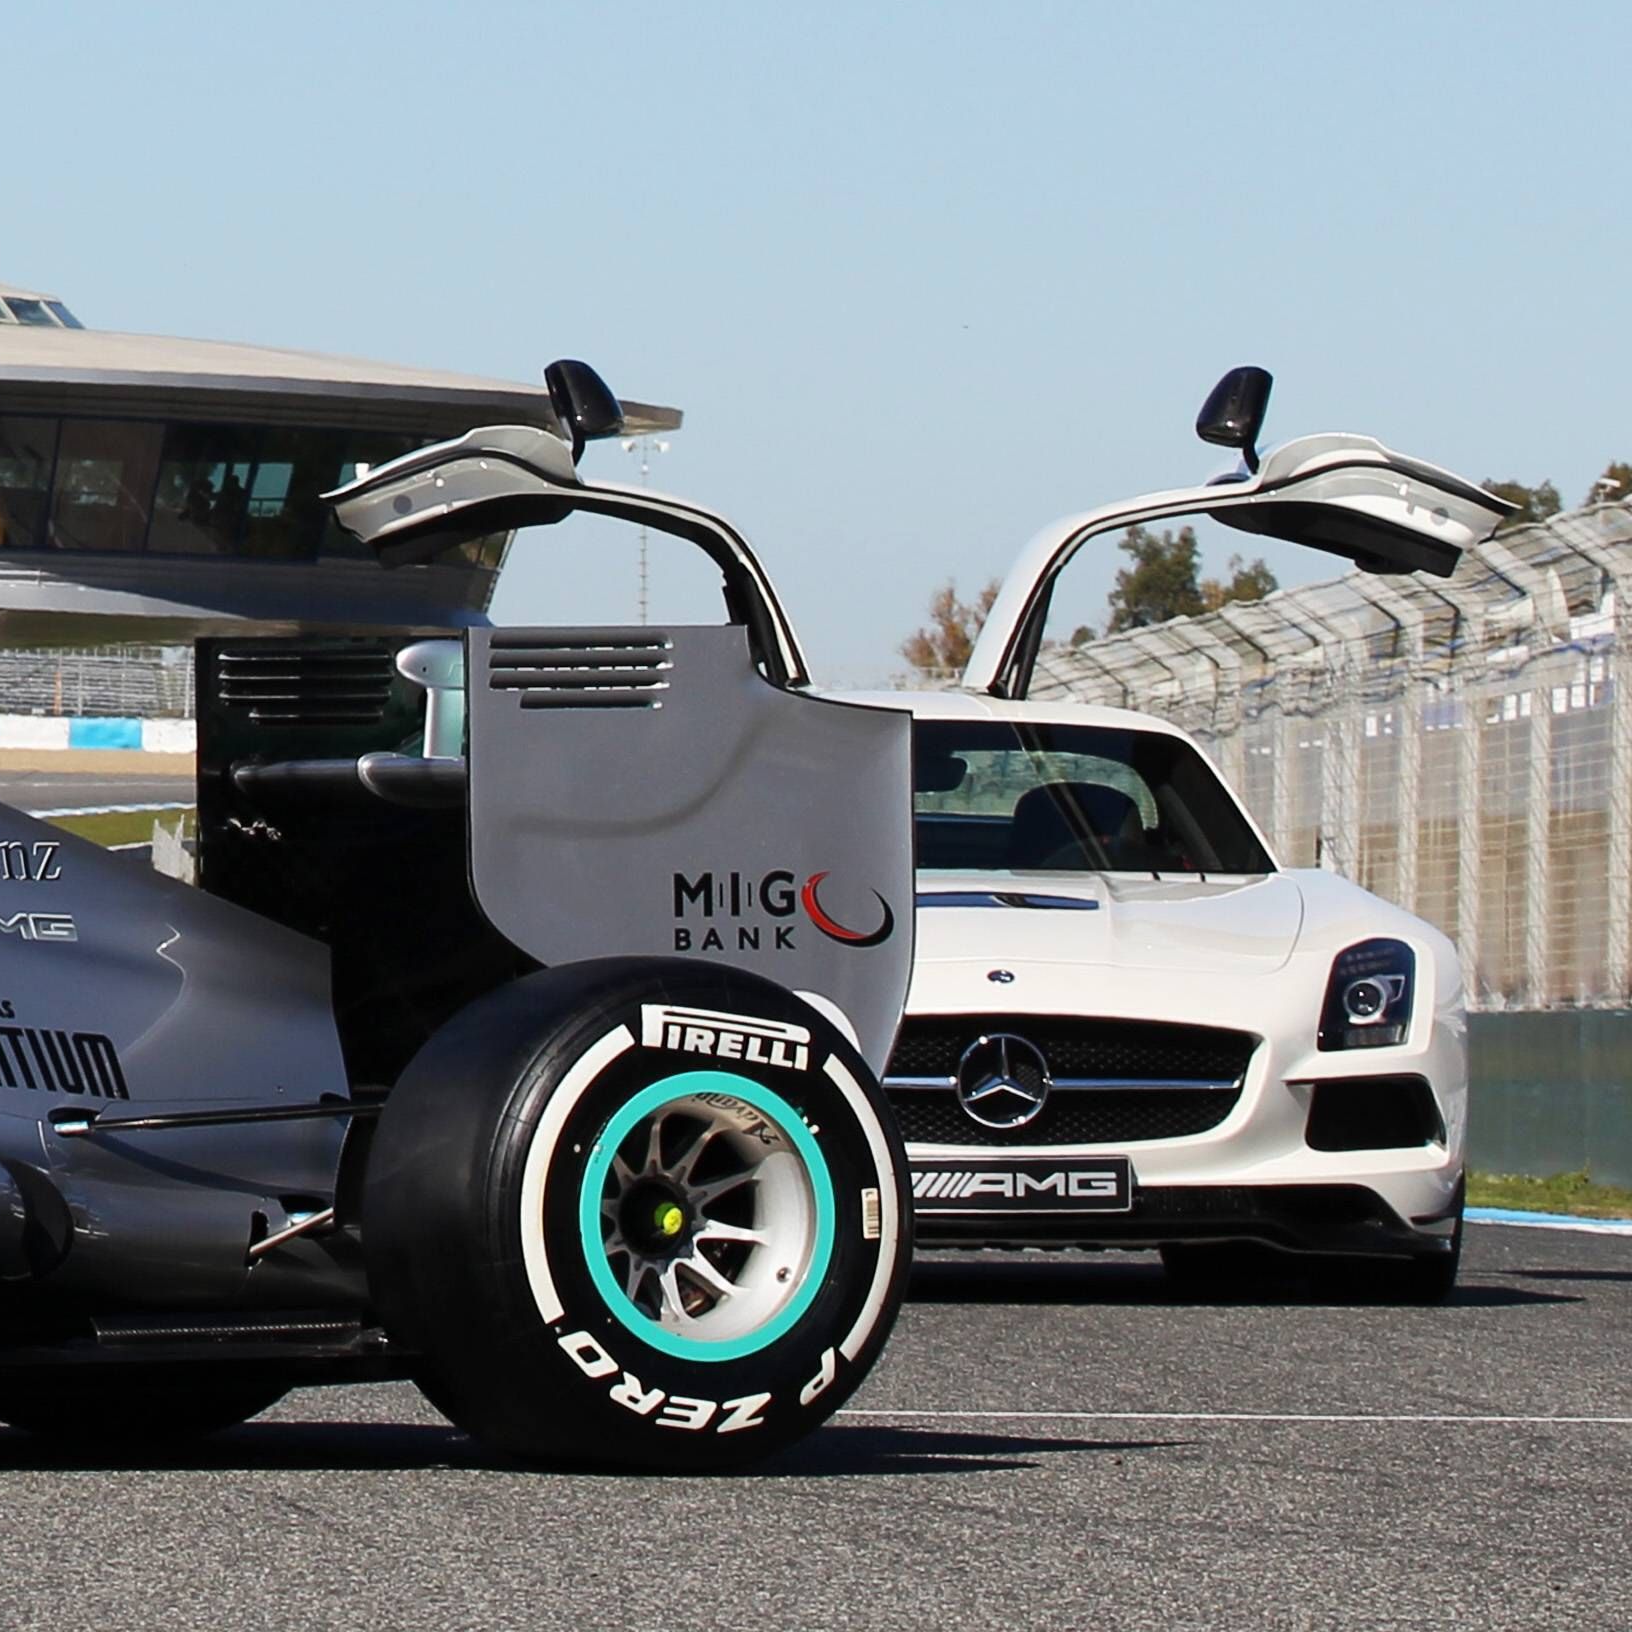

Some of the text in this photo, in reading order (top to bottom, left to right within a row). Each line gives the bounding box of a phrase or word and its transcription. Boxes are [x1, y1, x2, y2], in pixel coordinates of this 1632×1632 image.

[674, 926, 797, 951] BANK
[641, 1003, 811, 1072] PIRELLI
[557, 1330, 836, 1434] P ZERO
